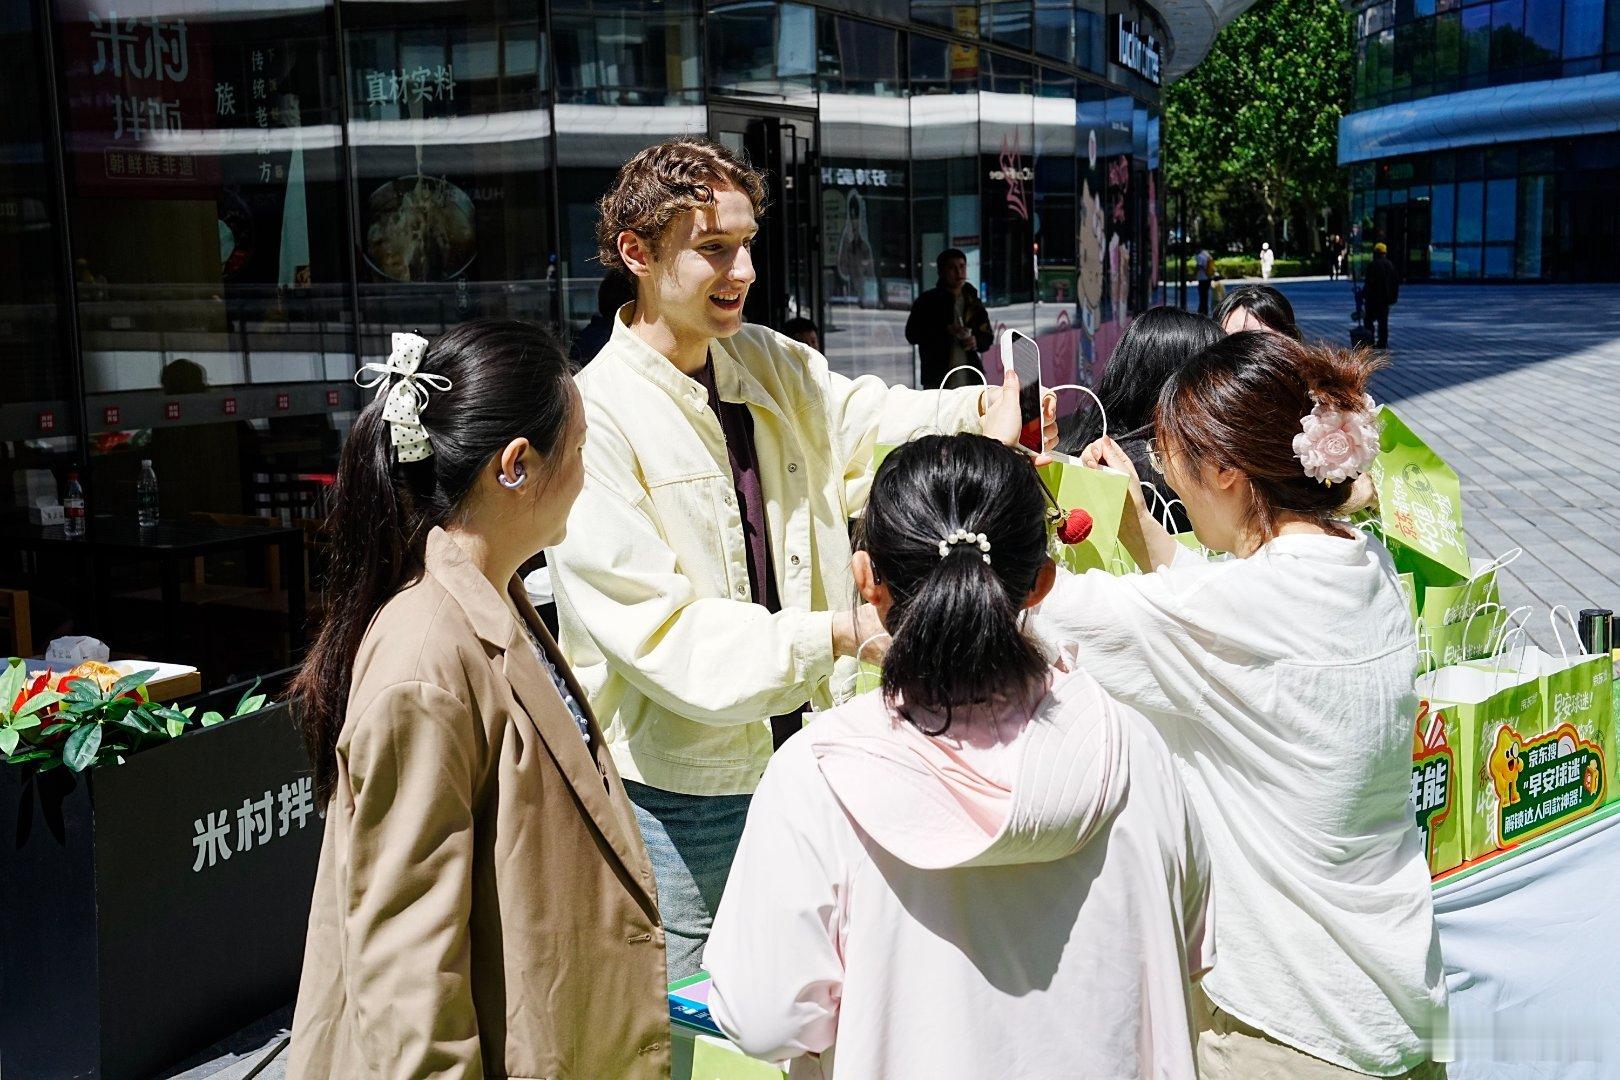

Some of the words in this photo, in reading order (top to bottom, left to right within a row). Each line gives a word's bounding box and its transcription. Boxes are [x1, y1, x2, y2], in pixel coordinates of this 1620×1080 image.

[89, 11, 190, 82] 米村
[214, 81, 237, 116] 族
[366, 64, 456, 107] 真材实料
[109, 151, 194, 176] 朝鲜族非遗
[1528, 742, 1557, 769] 京东搜
[193, 777, 326, 873] 米村拌
[1504, 786, 1583, 834] 解锁达人同款神器!
